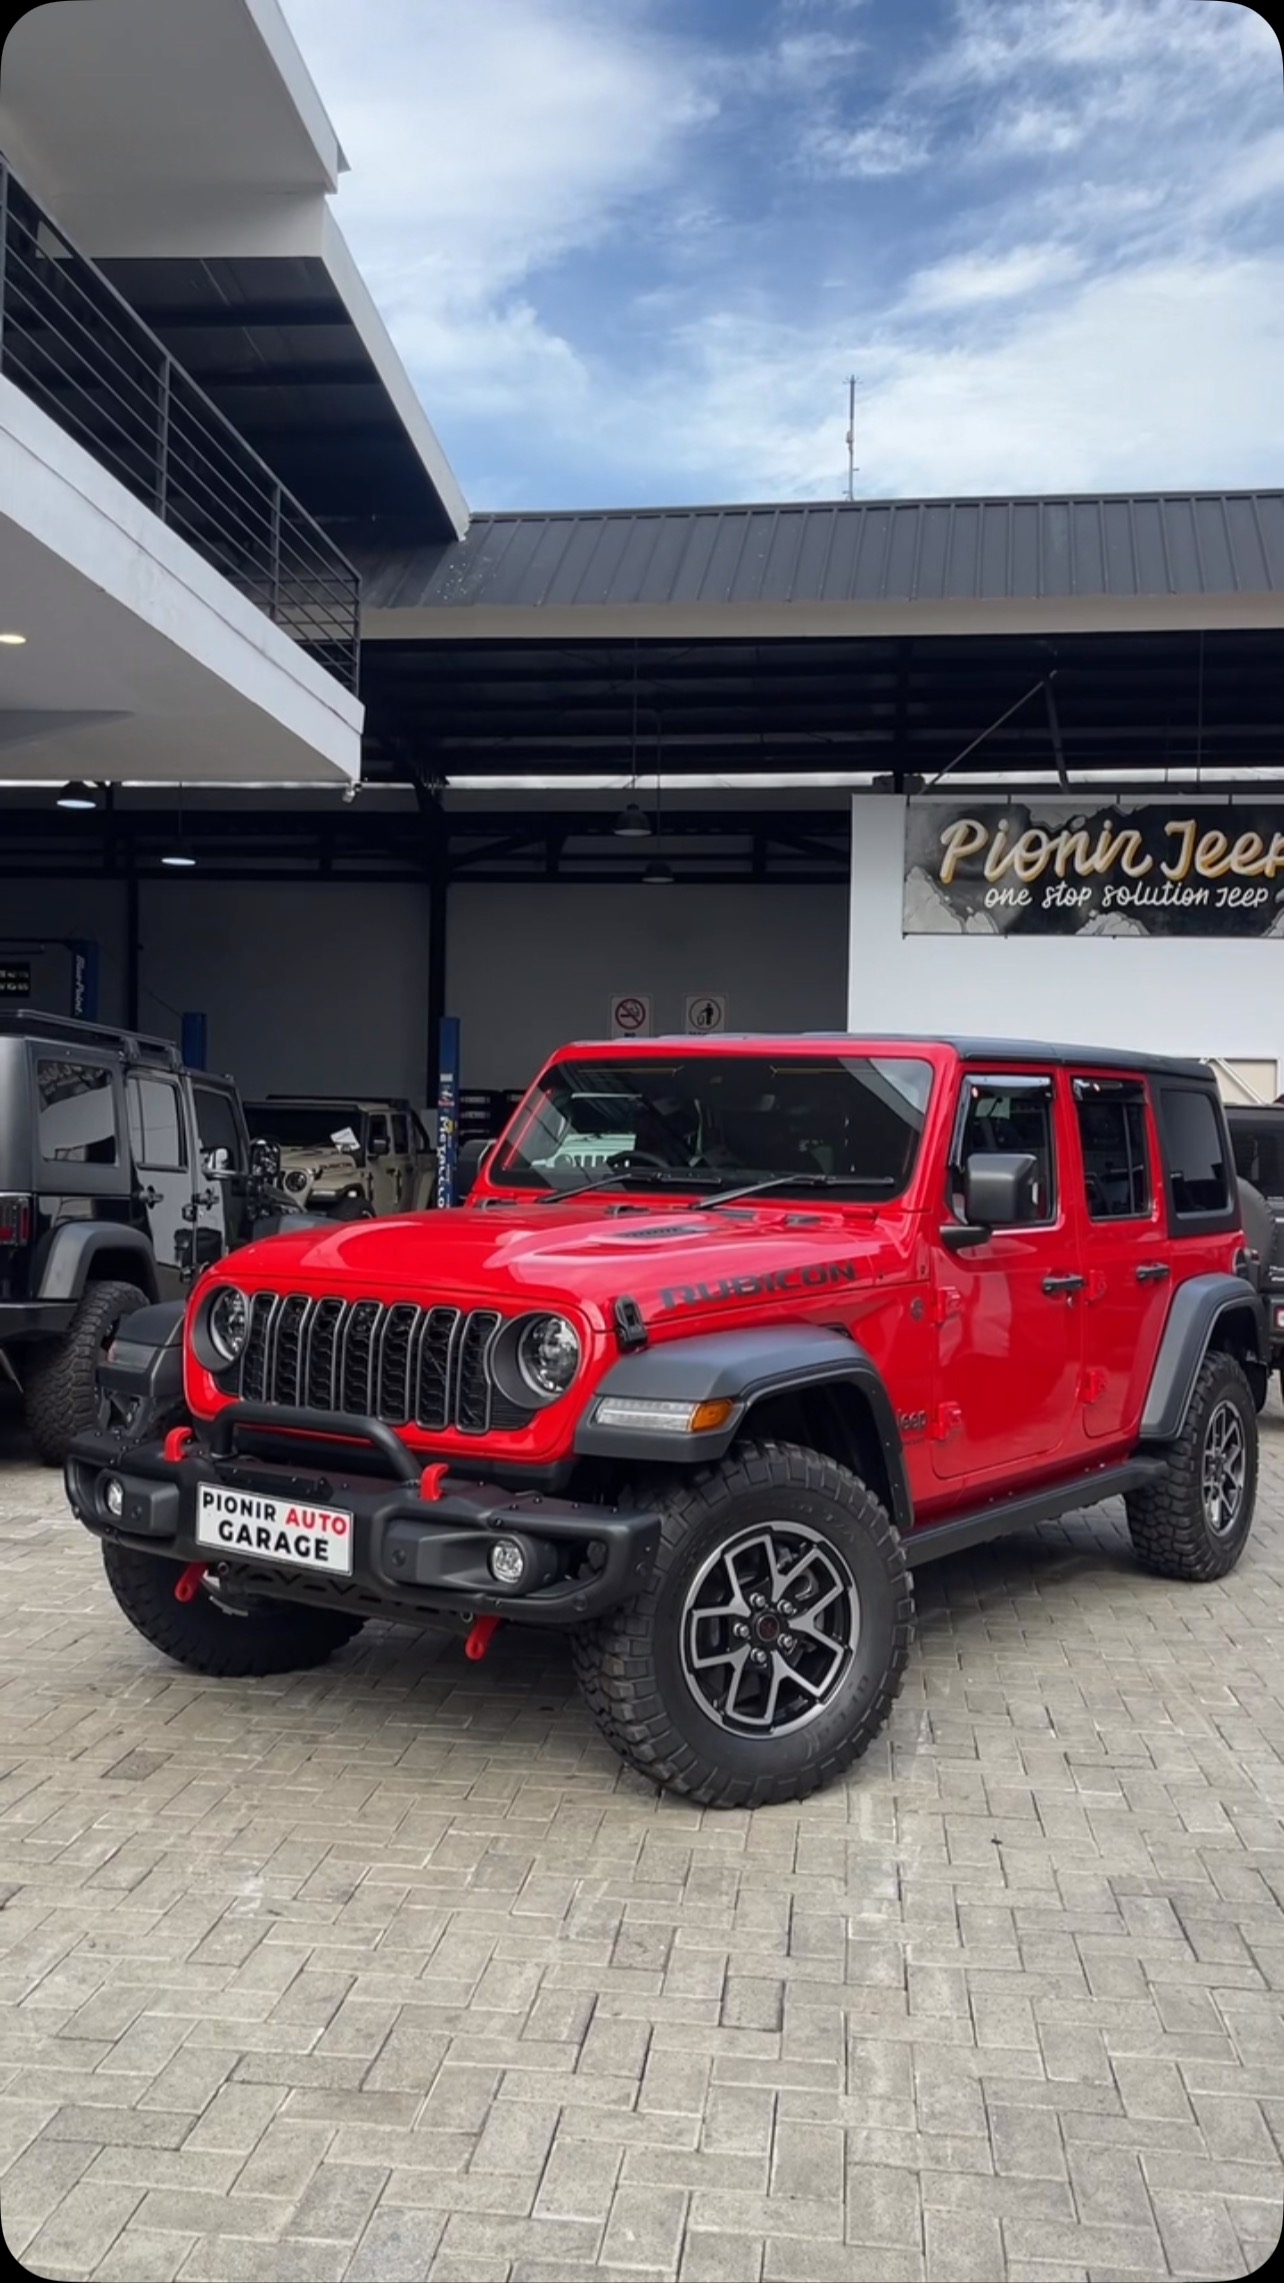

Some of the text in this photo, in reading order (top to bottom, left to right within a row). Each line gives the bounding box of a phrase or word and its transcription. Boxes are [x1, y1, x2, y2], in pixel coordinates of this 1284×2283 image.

[940, 819, 1153, 884] Pionir
[986, 885, 1032, 908] one
[1042, 881, 1091, 908] stop
[1102, 880, 1208, 907] solution
[660, 1261, 856, 1309] RUBICON
[203, 1492, 347, 1535] PIONIR AUTO
[218, 1519, 328, 1561] GARAGE
